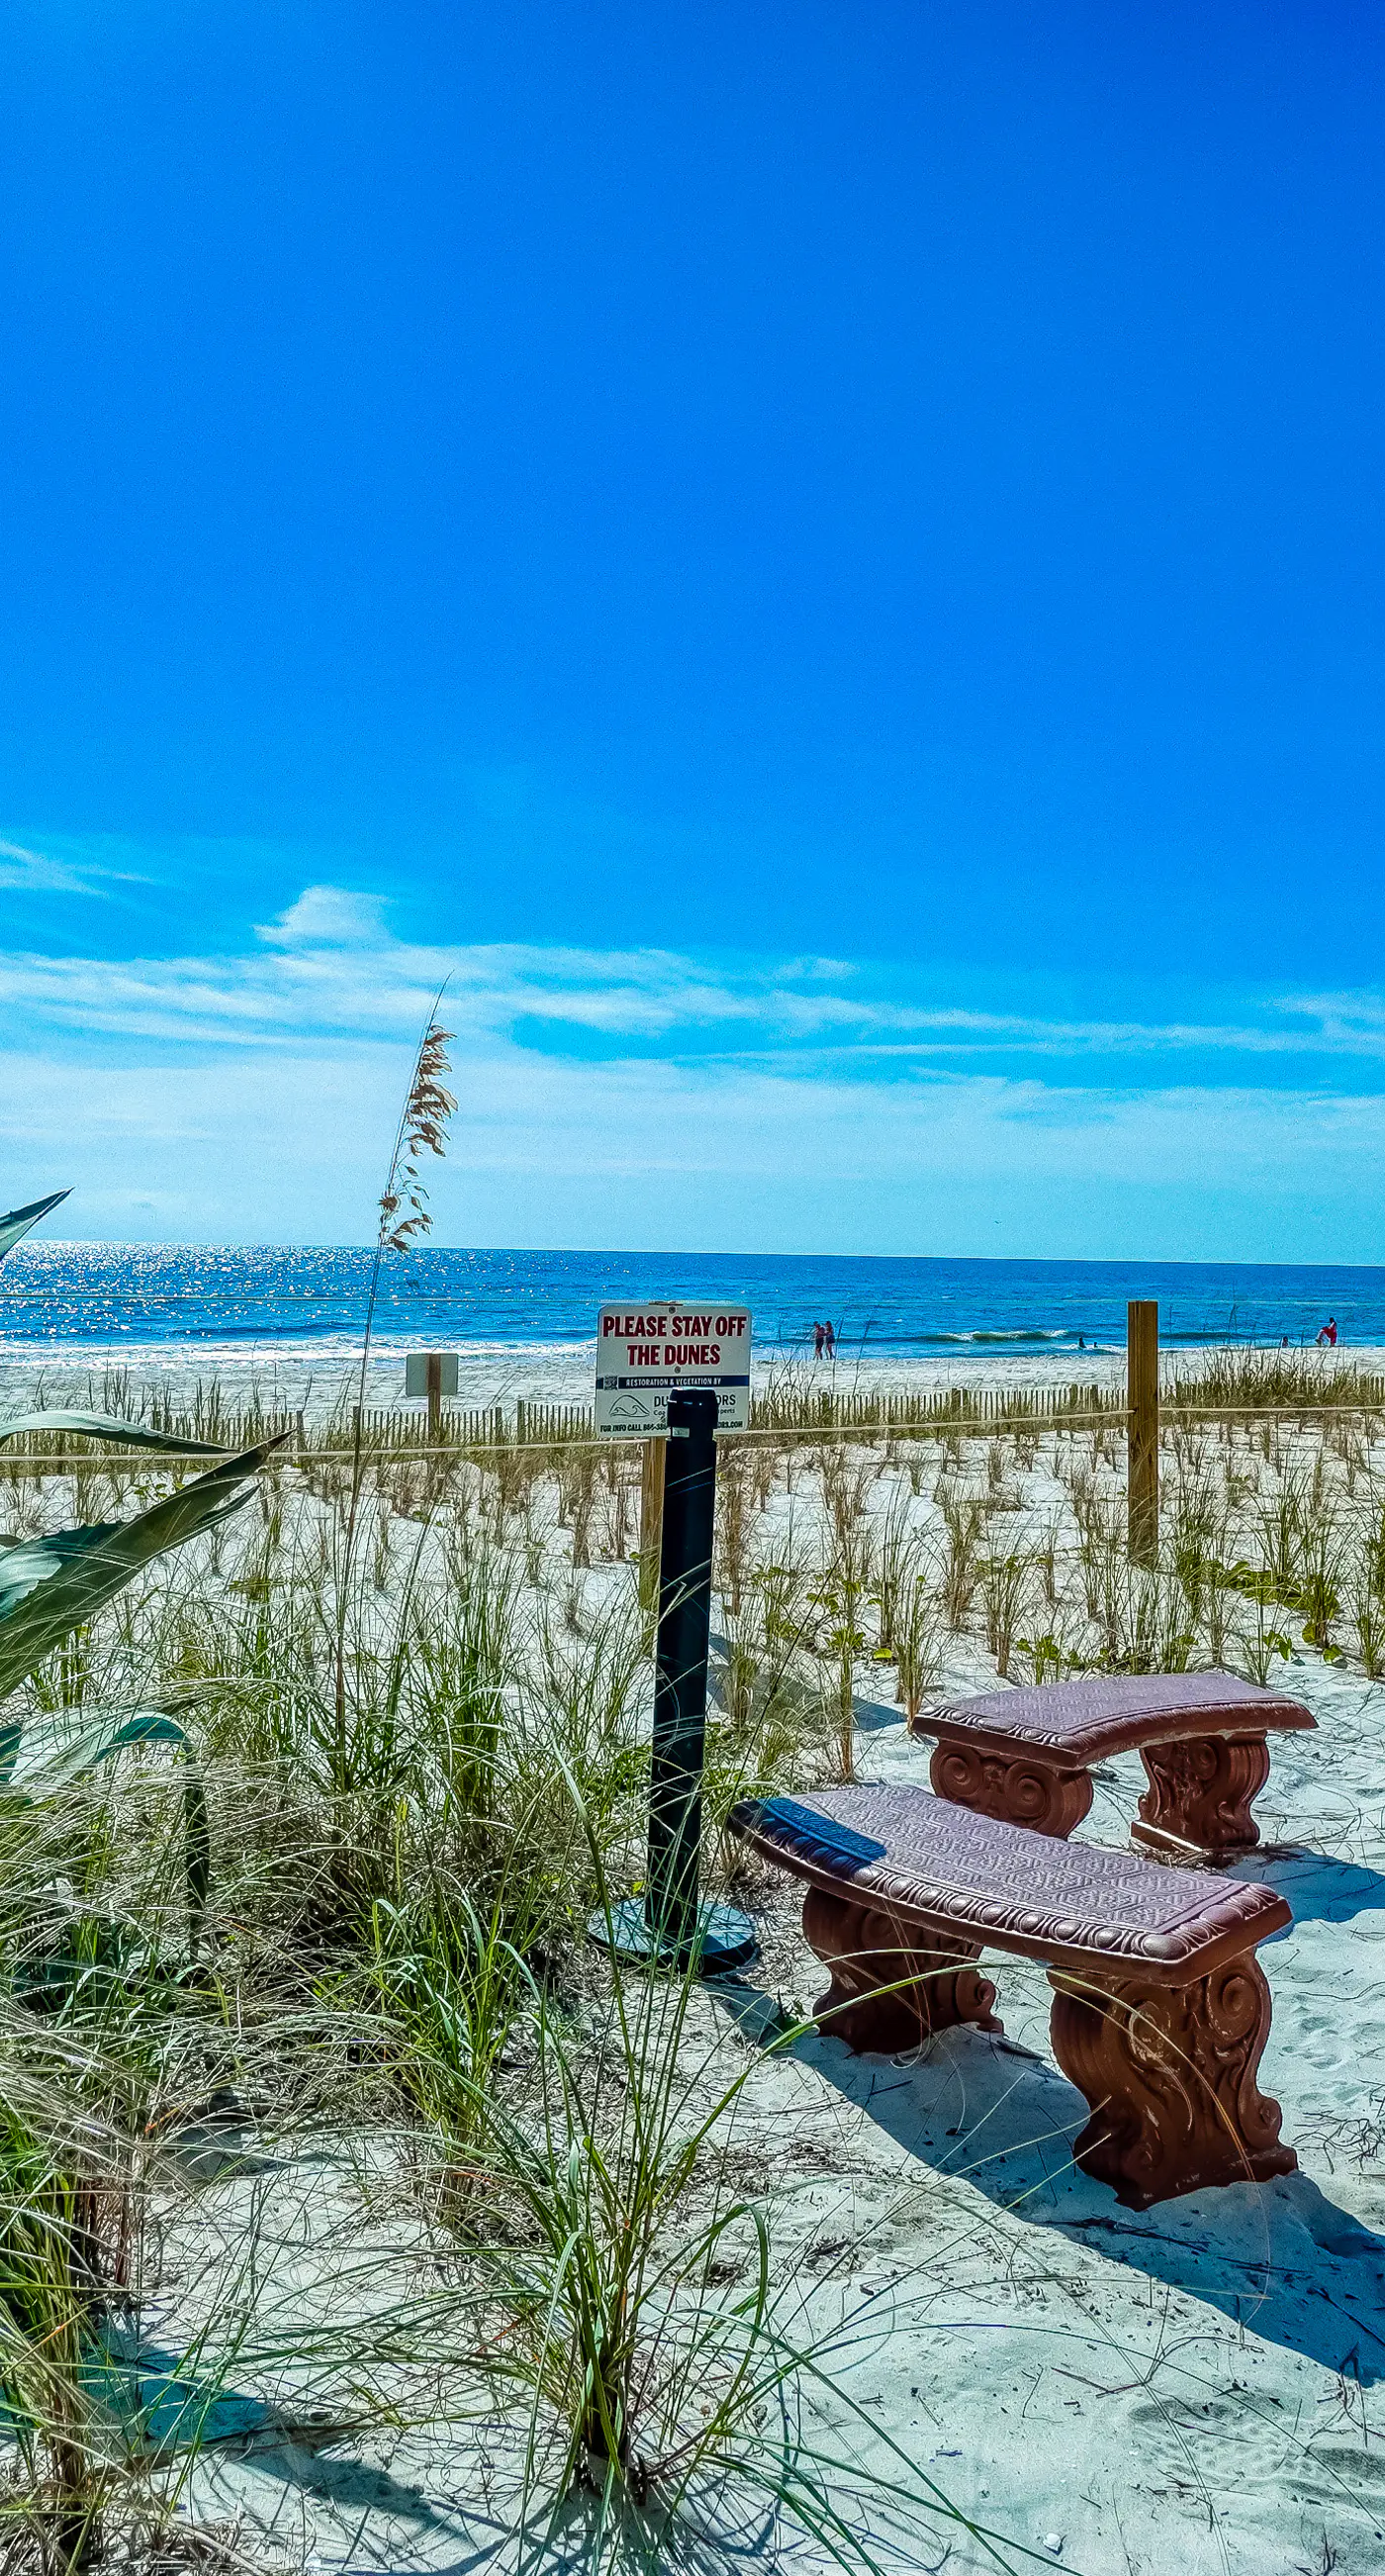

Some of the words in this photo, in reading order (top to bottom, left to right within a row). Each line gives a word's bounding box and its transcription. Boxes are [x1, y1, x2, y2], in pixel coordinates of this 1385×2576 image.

[602, 1315, 668, 1337] PLEASE
[672, 1315, 712, 1337] STAY
[714, 1315, 747, 1337] OFF
[627, 1345, 661, 1366] THE
[664, 1344, 720, 1366] DUNES
[654, 1395, 669, 1407] DU
[600, 1424, 612, 1433] FOR
[627, 1423, 642, 1432] CALL
